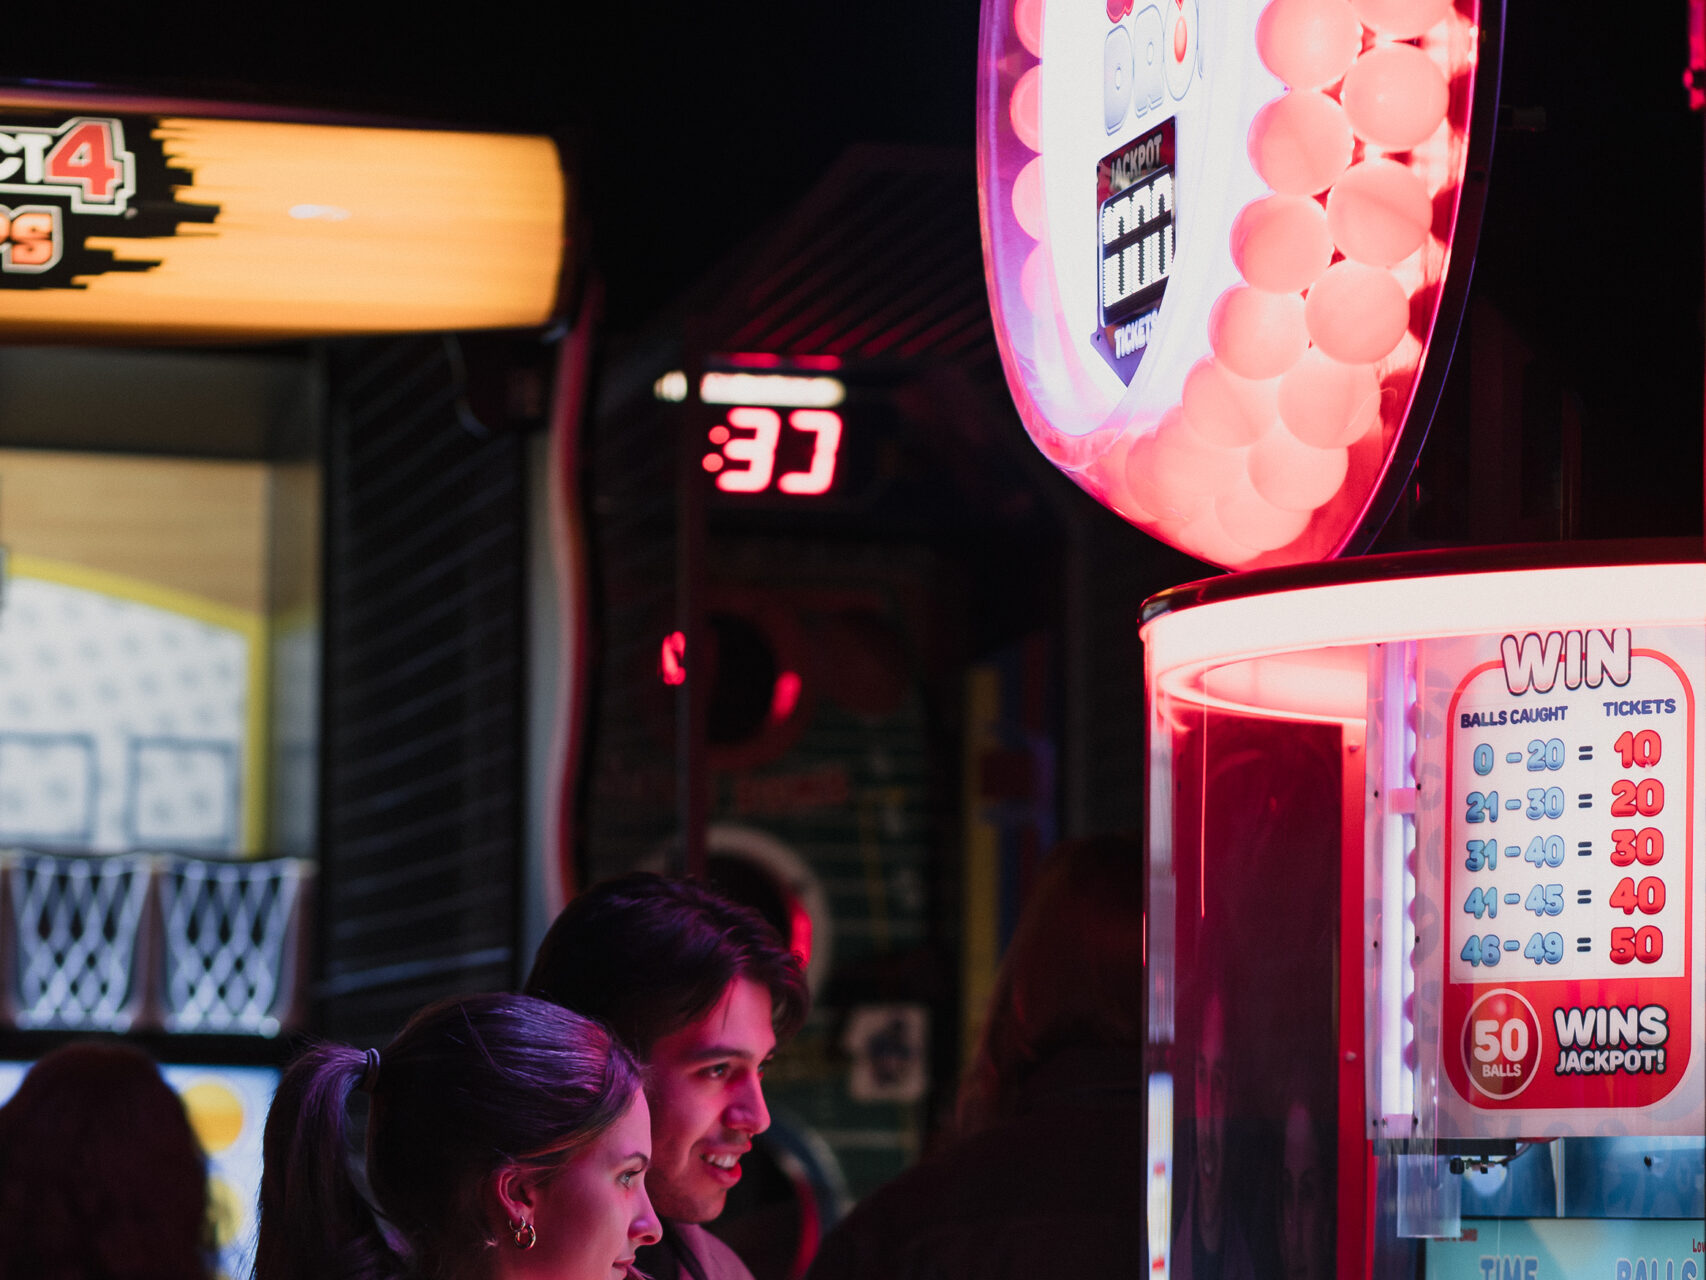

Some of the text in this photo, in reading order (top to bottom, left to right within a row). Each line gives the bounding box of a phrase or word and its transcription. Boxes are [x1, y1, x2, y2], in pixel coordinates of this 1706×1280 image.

[1110, 132, 1163, 188] JACKPOT
[0, 212, 53, 265] S
[1500, 628, 1632, 696] WIN
[1460, 705, 1568, 728] BALLS CAUGHT
[1603, 698, 1676, 717] TICKETS
[1614, 729, 1662, 768] 10
[1611, 778, 1665, 817] 20
[1610, 827, 1664, 867] 30
[1609, 876, 1666, 915] 40
[1610, 925, 1663, 965] 50
[1474, 1018, 1528, 1063] 50
[1554, 1005, 1668, 1048] WINS
[1482, 1064, 1521, 1077] BALLS
[1555, 1049, 1666, 1075] JACKPOT!
